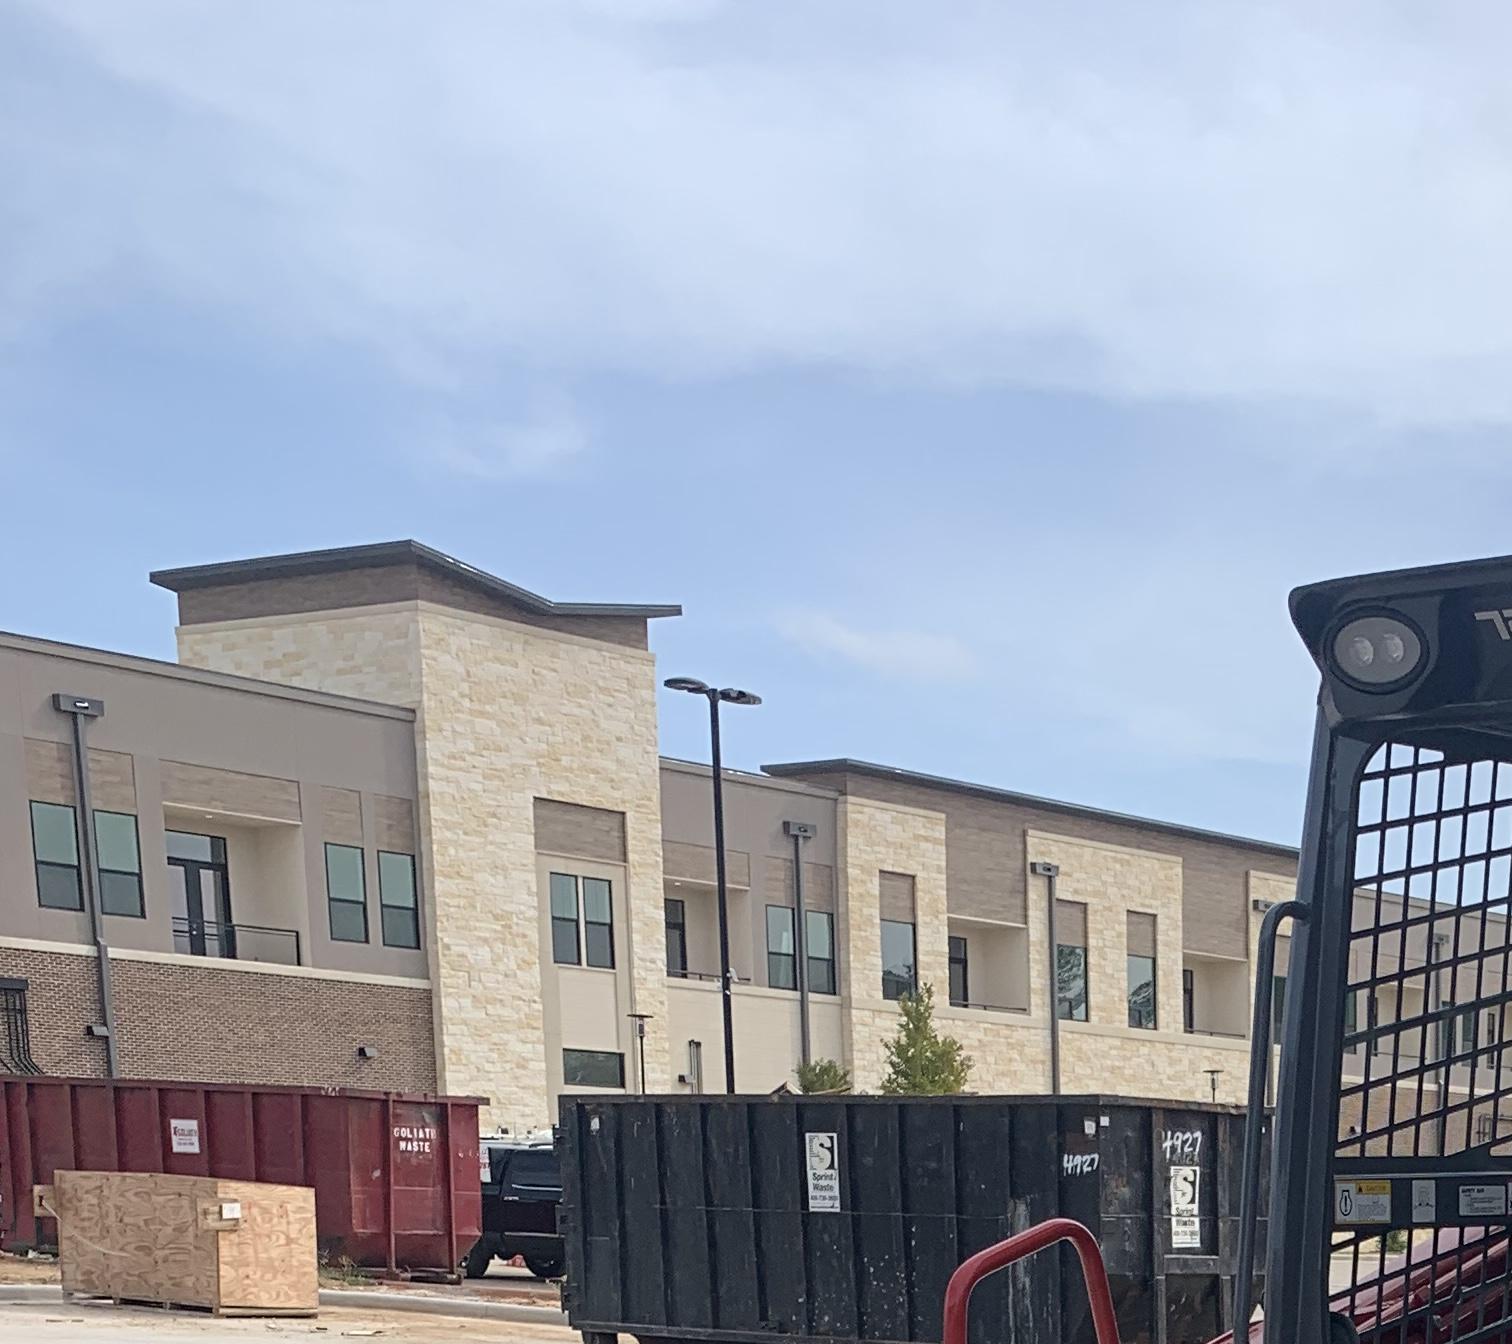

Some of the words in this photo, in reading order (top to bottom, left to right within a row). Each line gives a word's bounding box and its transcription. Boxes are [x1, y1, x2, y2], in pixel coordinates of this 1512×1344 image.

[393, 1127, 437, 1139] GOLIATH
[399, 1140, 430, 1152] WASTE
[1162, 1131, 1202, 1162] 4927
[1063, 1153, 1099, 1176] 4927
[812, 1172, 833, 1182] Sprint
[812, 1183, 834, 1192] Waste
